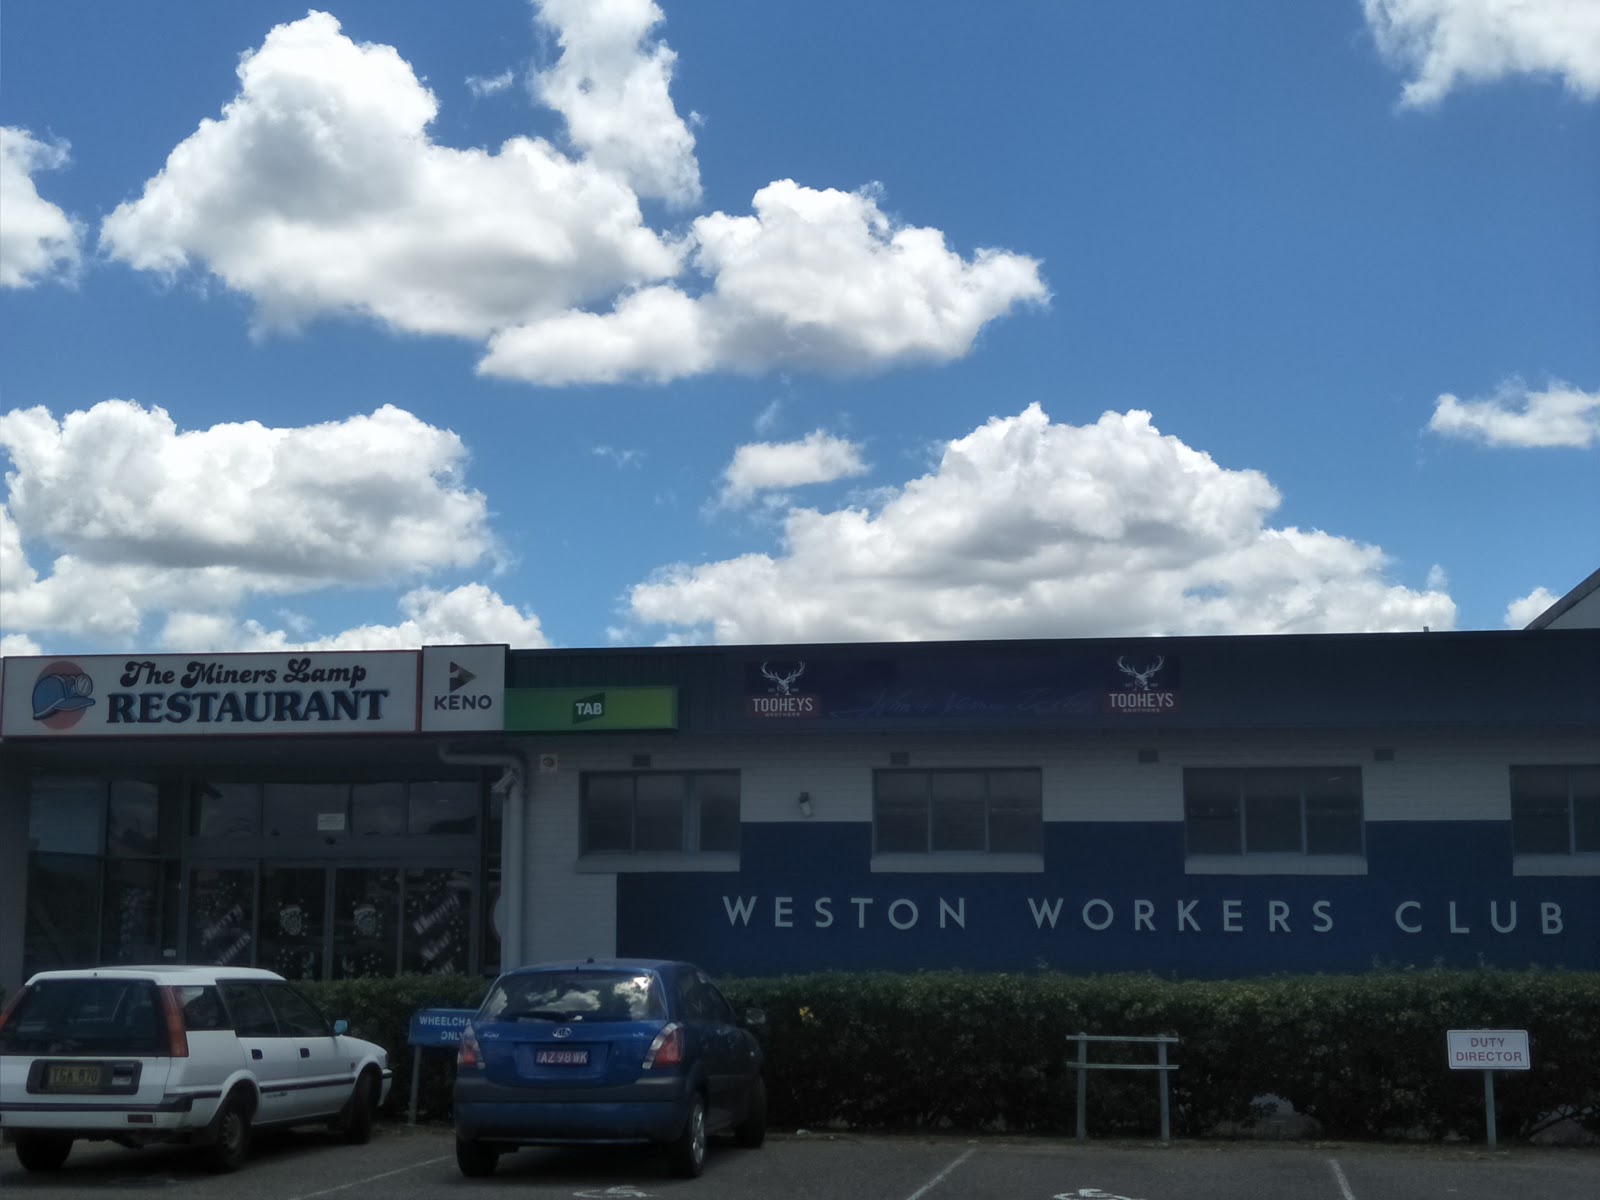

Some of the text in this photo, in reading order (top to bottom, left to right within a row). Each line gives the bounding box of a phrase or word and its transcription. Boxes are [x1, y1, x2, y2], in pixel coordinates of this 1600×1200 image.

[119, 657, 367, 689] The Miners Lamp
[106, 689, 389, 724] RESTAURANT
[434, 694, 492, 711] KENO
[752, 697, 814, 712] TOOHEYS
[1109, 693, 1174, 708] TOOHEYS
[575, 702, 603, 715] TAB
[722, 896, 1564, 935] WESTON WORKERS CLUB
[1470, 1037, 1505, 1048] DUTY
[1456, 1051, 1522, 1062] DIRECTOR
